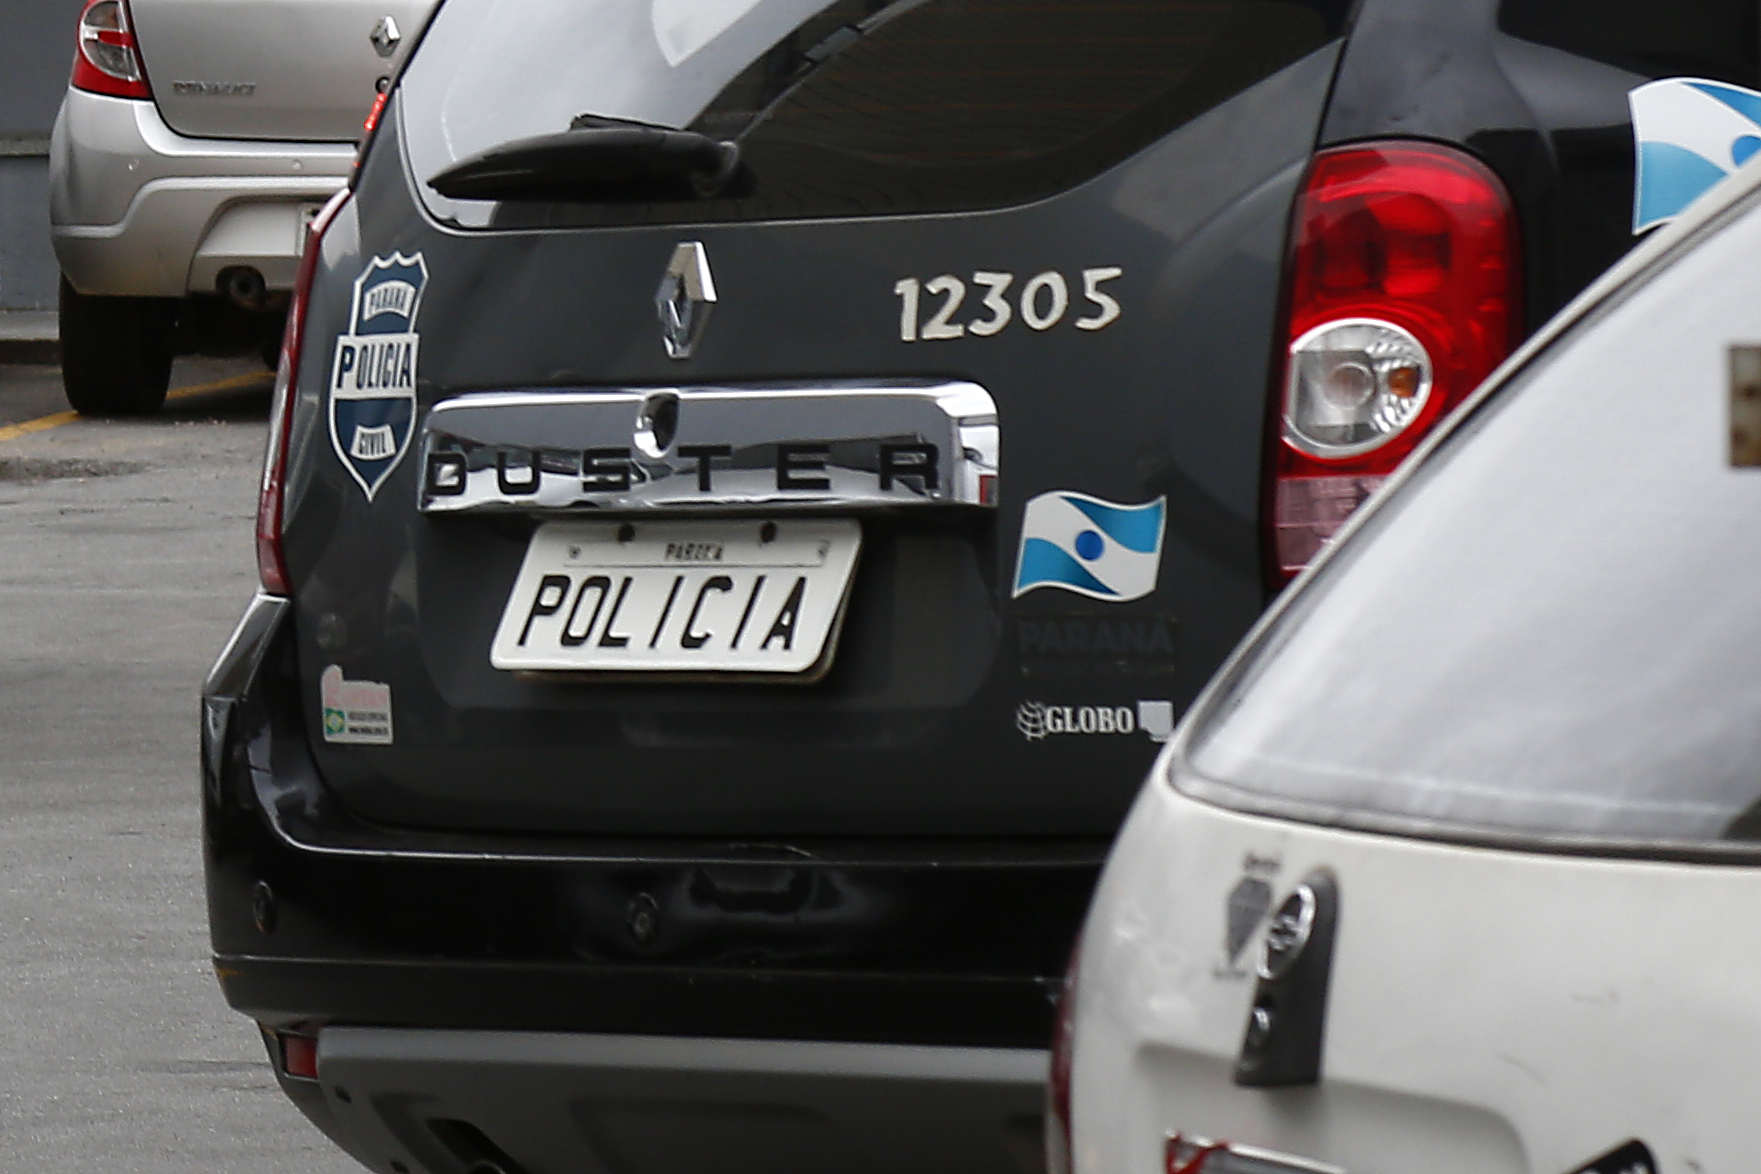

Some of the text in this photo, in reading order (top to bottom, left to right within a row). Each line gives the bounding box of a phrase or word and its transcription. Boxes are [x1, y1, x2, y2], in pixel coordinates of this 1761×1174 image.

[894, 266, 1123, 342] 12305
[428, 443, 939, 497] DUSTER
[516, 575, 807, 650] POLICIA
[1045, 706, 1135, 734] GLOBO
